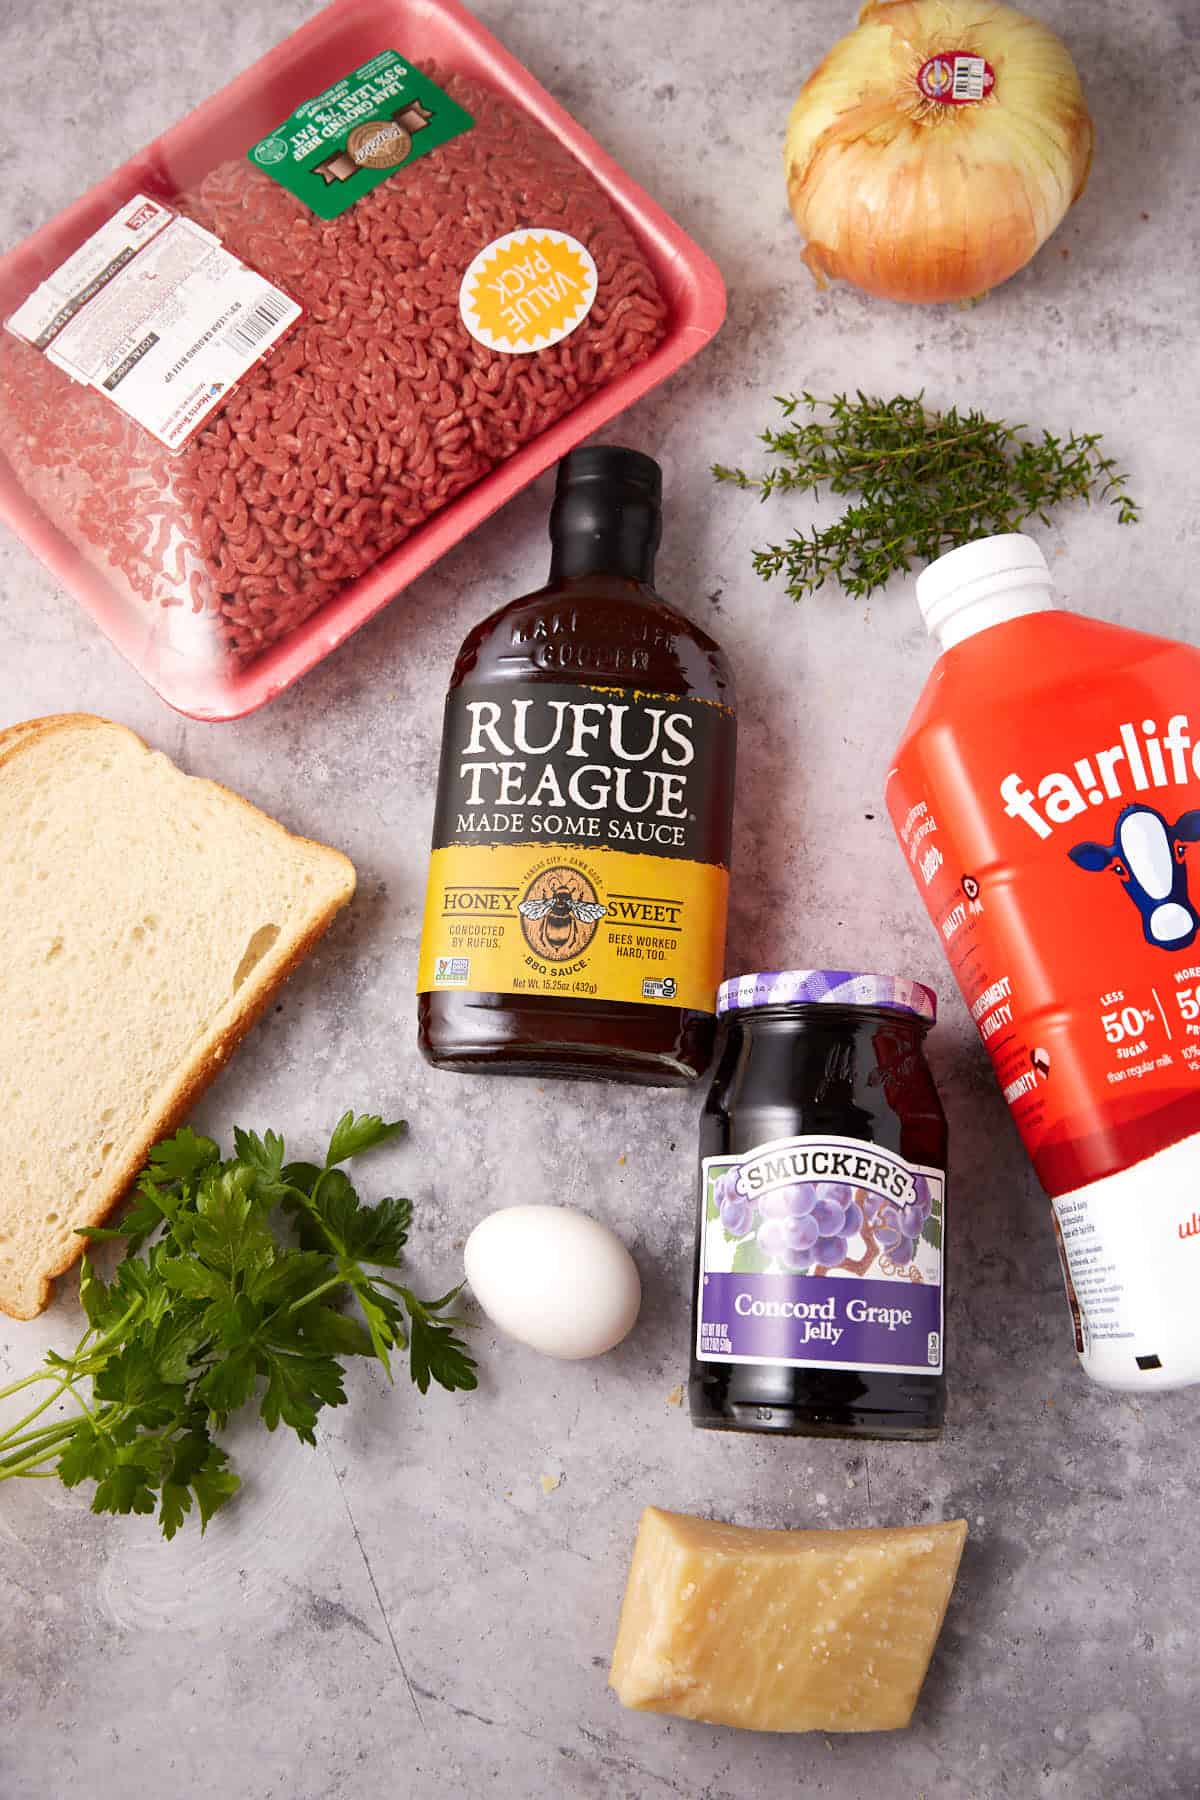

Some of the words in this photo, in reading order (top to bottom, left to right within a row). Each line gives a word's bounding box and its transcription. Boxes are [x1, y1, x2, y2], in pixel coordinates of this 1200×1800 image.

[374, 64, 408, 87] 93%
[338, 83, 377, 111] LEAN
[371, 81, 404, 104] LEAN
[315, 108, 341, 125] 7%
[321, 100, 373, 138] GROUND
[290, 123, 319, 147] FAT
[293, 136, 324, 161] BEEF
[488, 250, 551, 305] PACK
[500, 271, 579, 334] VALUE
[461, 699, 695, 767] RUFUS
[455, 813, 525, 833] MADE
[530, 815, 601, 837] SOME
[608, 820, 686, 846] SAUCE
[443, 893, 519, 910] HONEY
[607, 901, 682, 923] SWEET
[449, 924, 505, 937] CONCOCTED
[608, 933, 633, 945] BEES
[636, 935, 677, 950] WORKED
[452, 937, 464, 948] BY
[616, 946, 644, 960] HARD,
[524, 956, 547, 975] BBQ
[550, 960, 588, 977] SAUCE
[1173, 966, 1200, 983] MORE
[513, 978, 527, 988] Net
[572, 981, 598, 994] (432g)
[1100, 990, 1125, 1007] LESS
[1176, 985, 1200, 1020] 5
[1101, 1007, 1156, 1043] 50%
[1116, 1040, 1149, 1059] SUGAR
[1126, 1060, 1155, 1079] regular
[1156, 1053, 1174, 1068] milk
[748, 1152, 908, 1196] SMUCKER'S
[735, 1293, 836, 1320] Concord
[846, 1299, 912, 1331] Grape
[800, 1322, 844, 1345] Jelly
